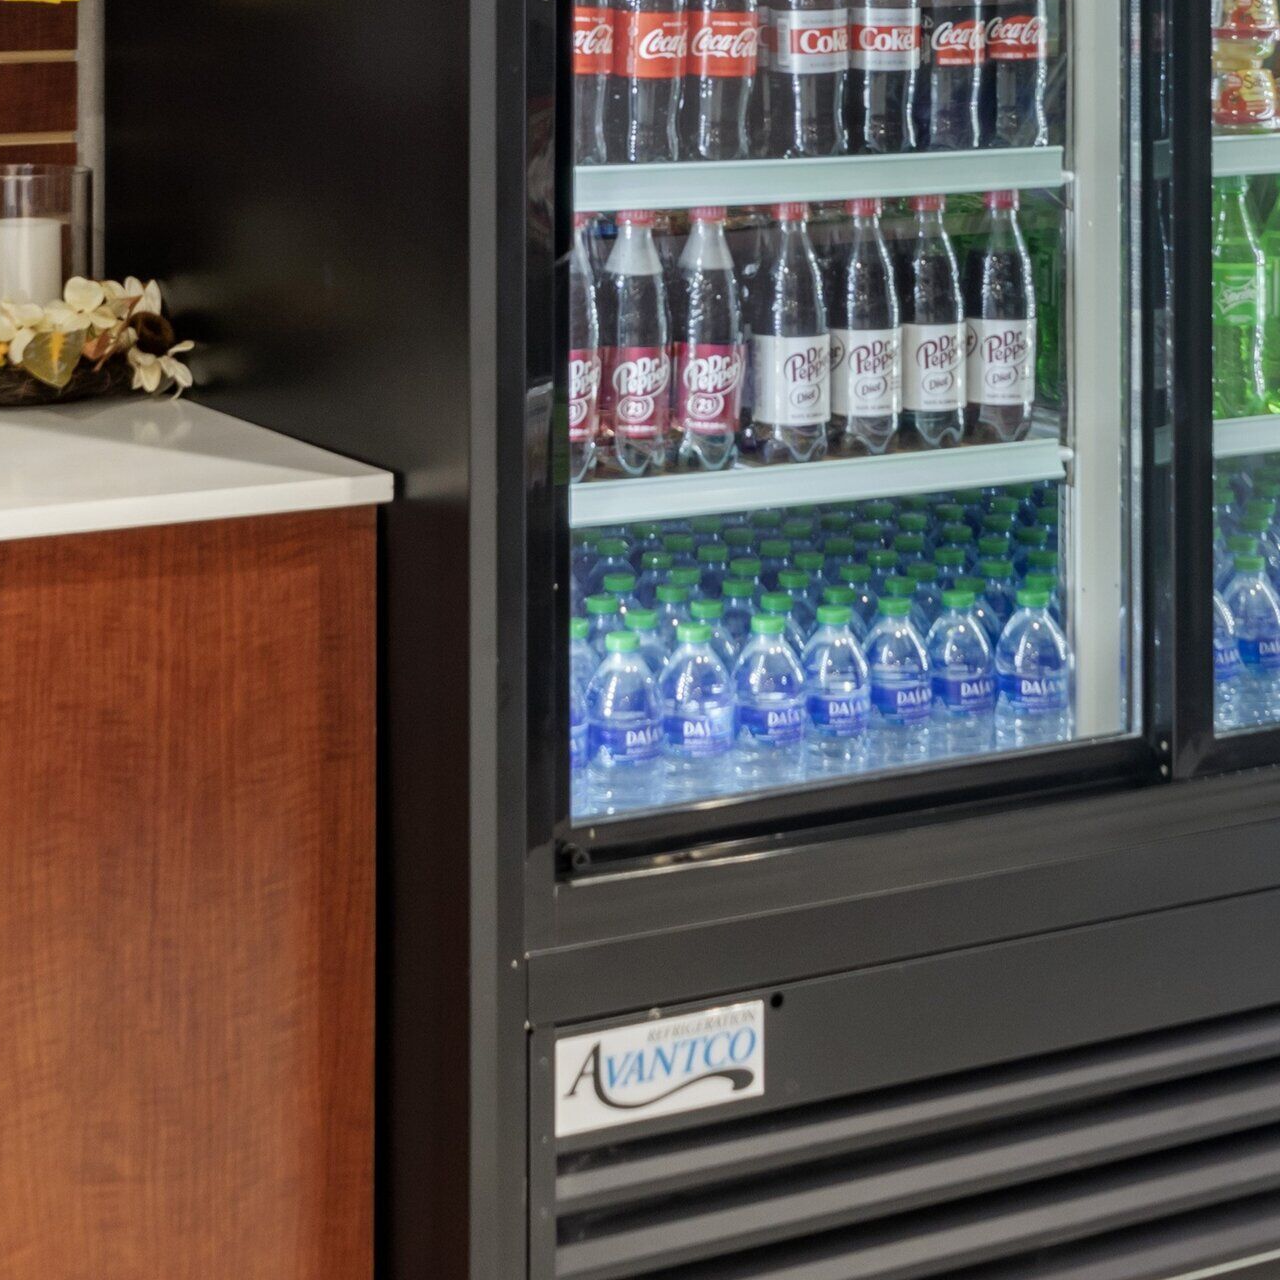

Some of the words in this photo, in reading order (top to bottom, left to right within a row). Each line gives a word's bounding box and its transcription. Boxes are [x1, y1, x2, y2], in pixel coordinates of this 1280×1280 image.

[859, 27, 914, 52] Coke
[1003, 330, 1023, 347] Dr
[871, 339, 891, 356] Dr
[637, 356, 660, 377] Dr
[707, 354, 731, 375] Dr
[619, 362, 668, 396] Pepper
[689, 360, 741, 394] Pepper
[929, 376, 950, 391] Diet
[991, 369, 1012, 385] Diet
[797, 389, 817, 404] Diet
[861, 381, 883, 397] Diet
[627, 402, 643, 415] 23
[696, 400, 712, 414] 23
[563, 1026, 757, 1109] AVANTCO
